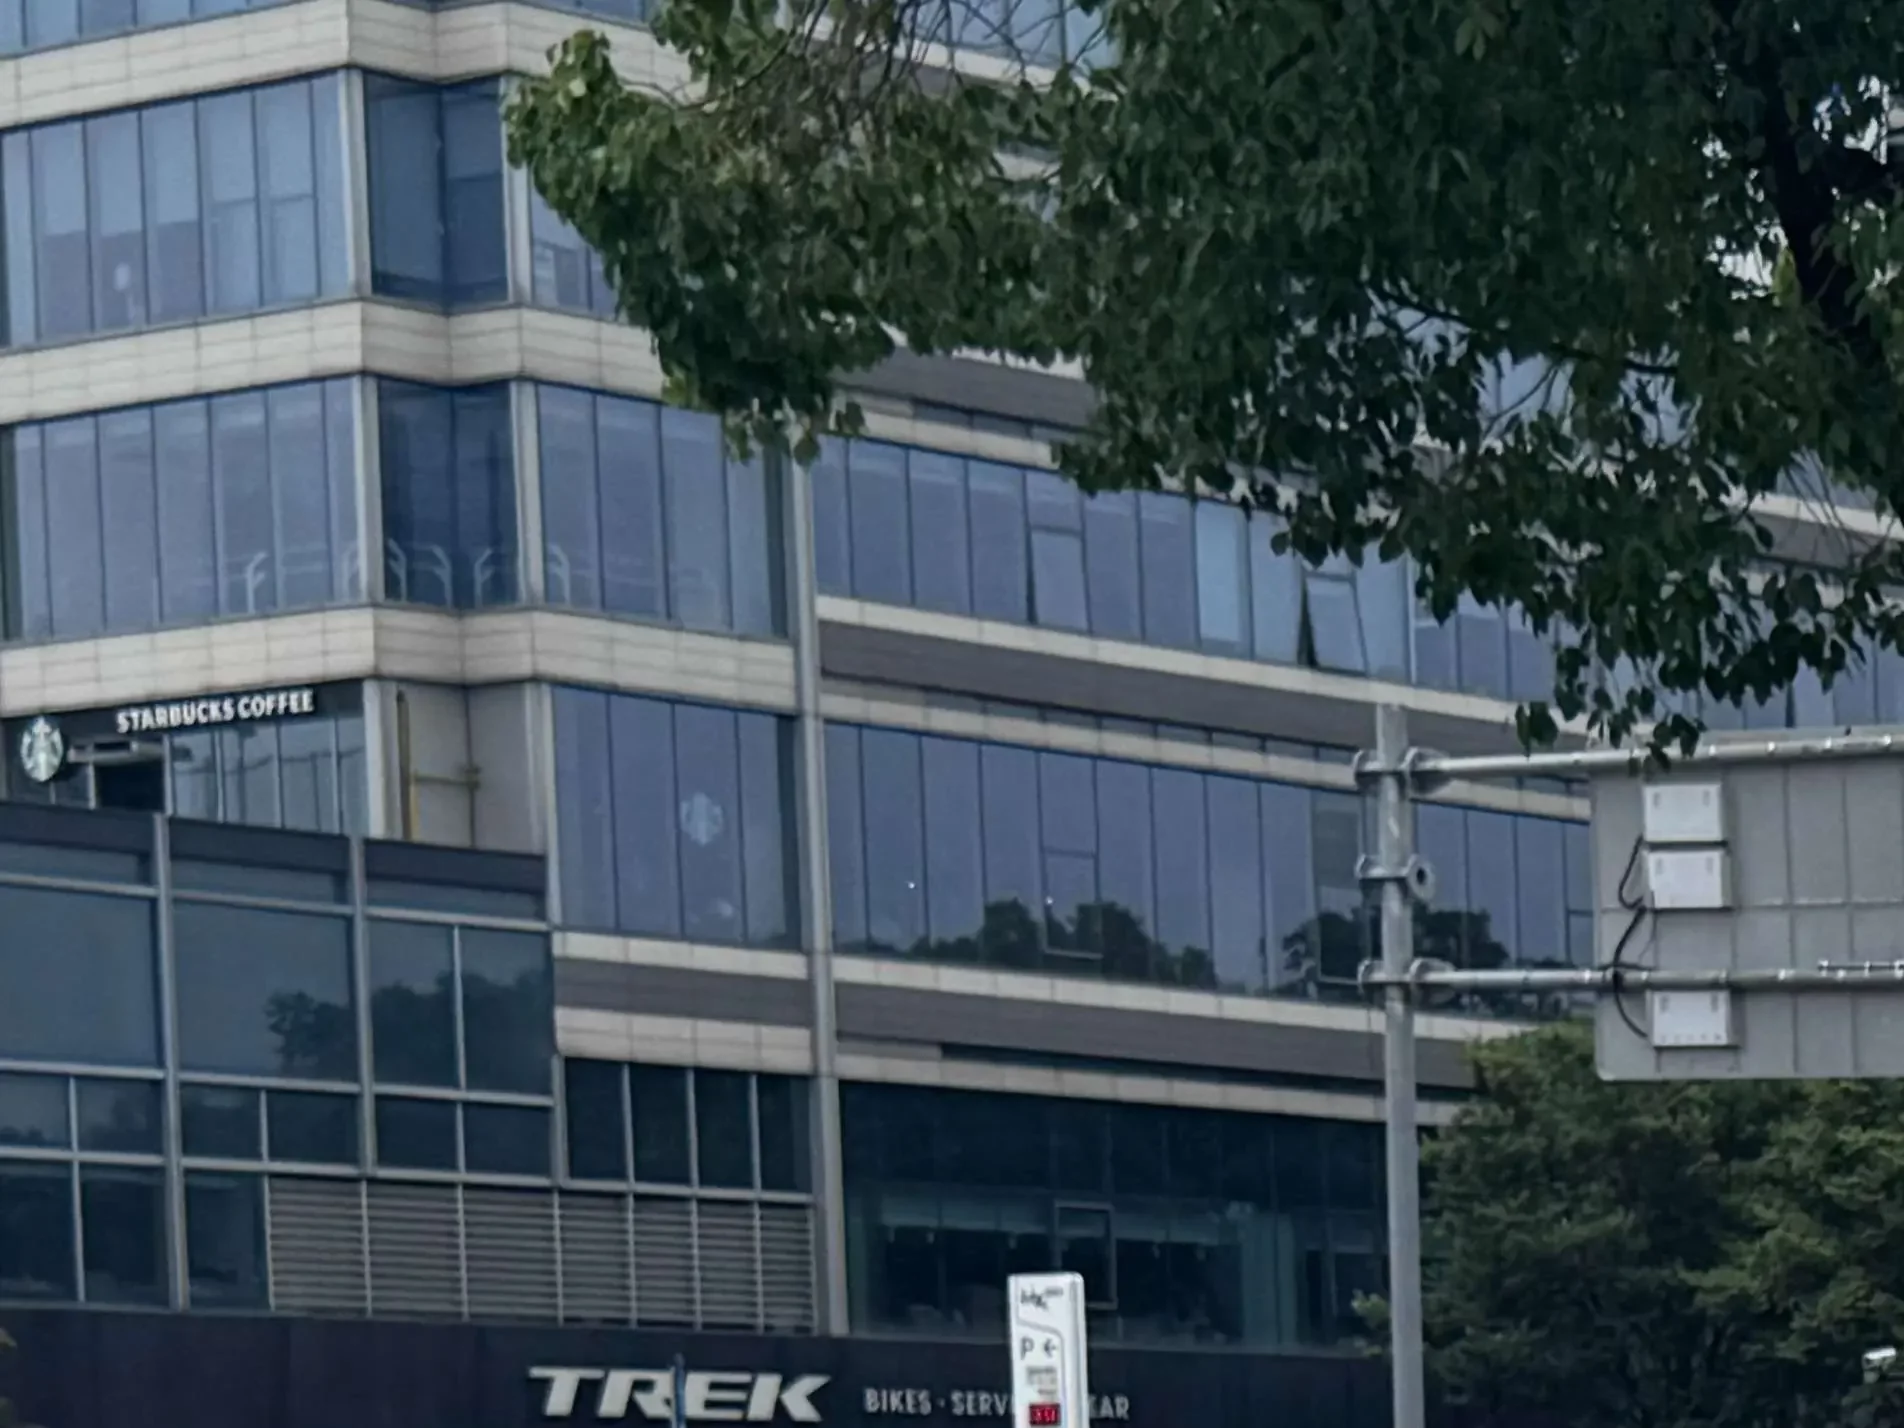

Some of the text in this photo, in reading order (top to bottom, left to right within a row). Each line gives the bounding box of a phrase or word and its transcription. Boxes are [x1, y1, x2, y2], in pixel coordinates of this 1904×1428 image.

[116, 688, 314, 735] STARBUCKS COFFEE
[529, 1366, 831, 1423] TREK
[864, 1388, 932, 1416] BIKES
